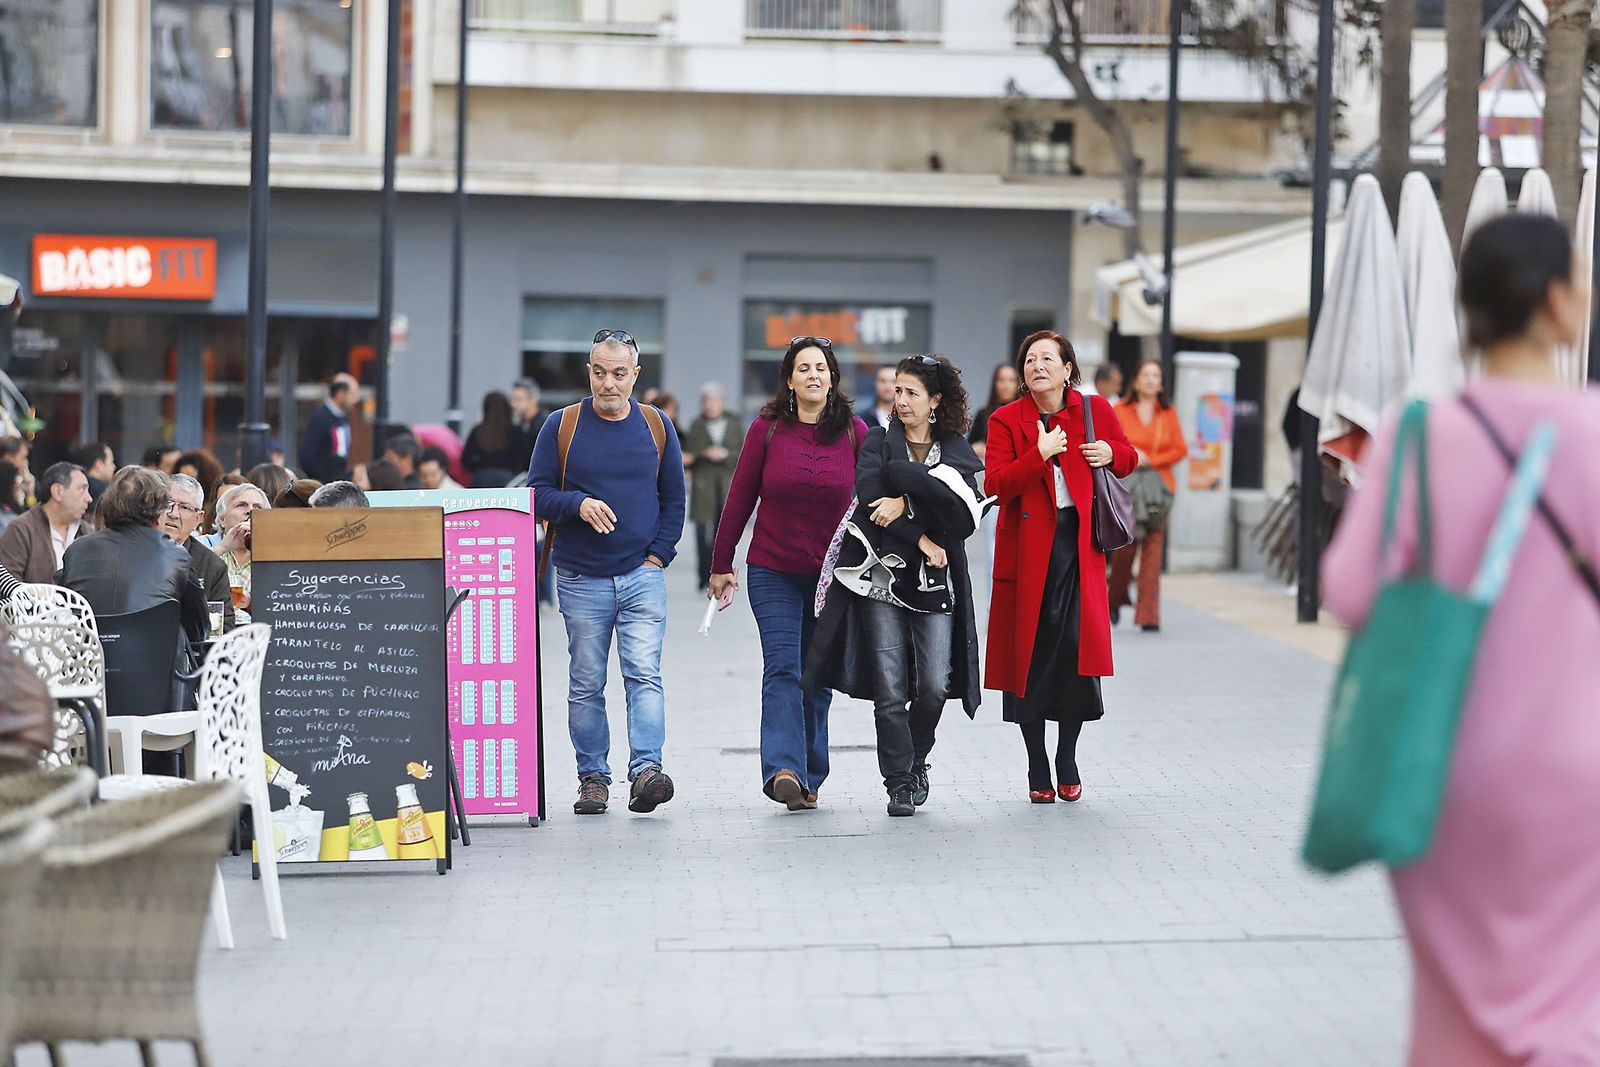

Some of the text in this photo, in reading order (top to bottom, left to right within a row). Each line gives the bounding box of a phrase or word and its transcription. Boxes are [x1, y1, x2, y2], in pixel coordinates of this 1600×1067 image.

[39, 245, 207, 292] BASIC FIT
[281, 569, 406, 594] Sugerencias
[274, 619, 347, 630] HAMBURGUESA
[358, 622, 373, 631] DE
[274, 637, 342, 651] TARANTELO
[354, 644, 365, 654] AL
[275, 659, 418, 675] CROQUETAS DE MERLUZA
[279, 673, 286, 682] Y
[275, 688, 335, 698] CROQUETAS
[341, 688, 355, 698] DE
[274, 708, 331, 718] CROQUETAS
